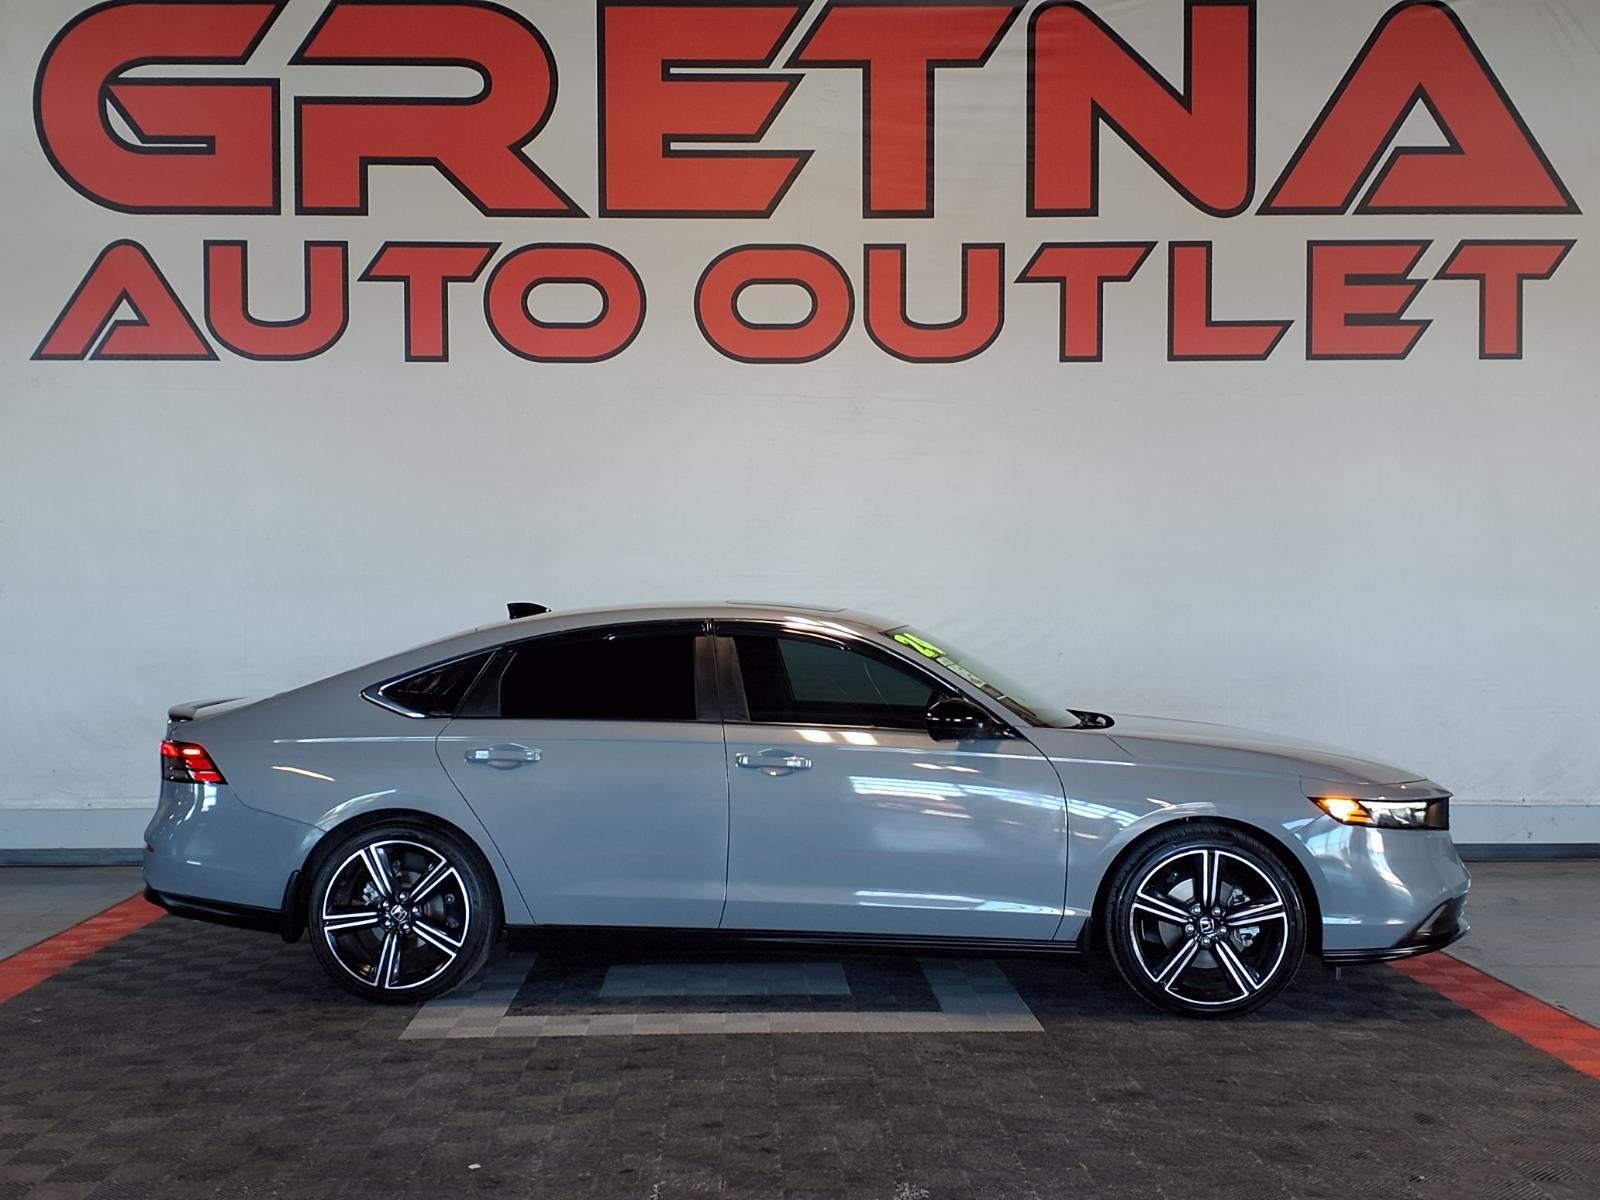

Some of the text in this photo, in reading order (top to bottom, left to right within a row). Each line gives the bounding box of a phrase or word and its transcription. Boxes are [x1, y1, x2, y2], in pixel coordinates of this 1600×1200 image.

[33, 0, 1583, 218] GRETNA
[30, 239, 1578, 364] AUTO OUTLET
